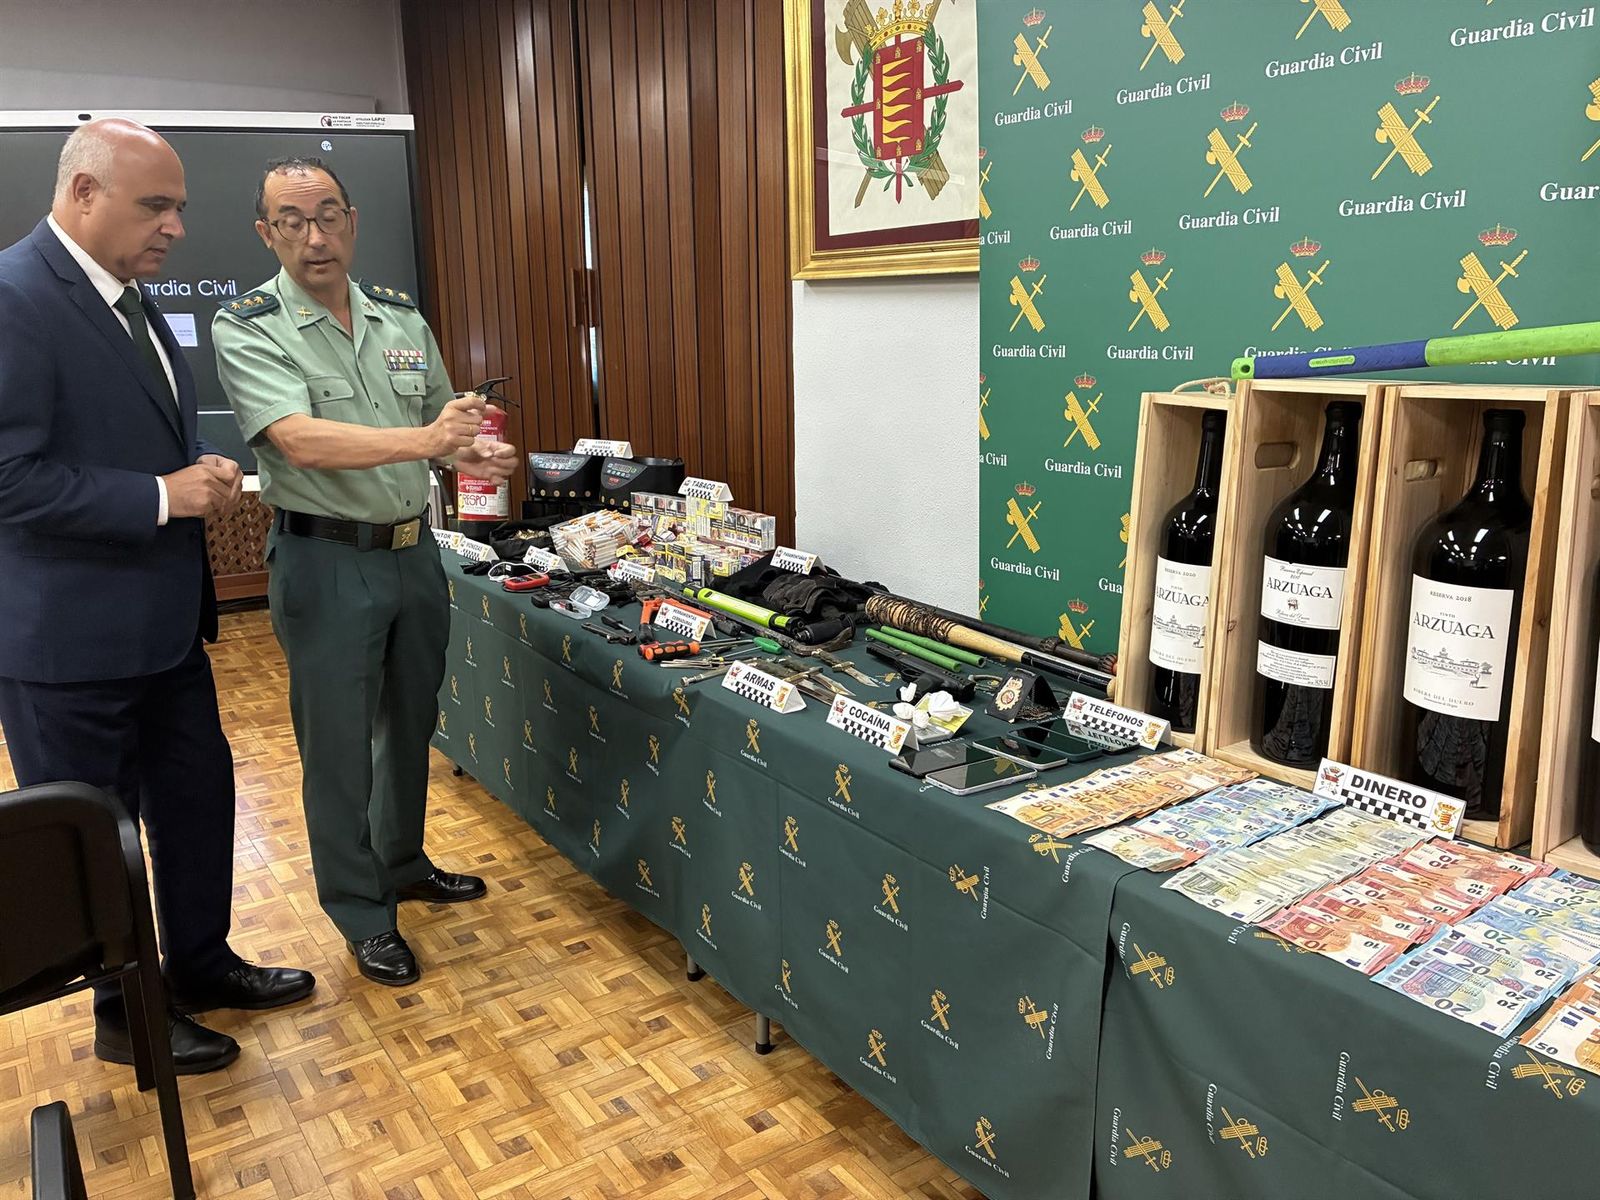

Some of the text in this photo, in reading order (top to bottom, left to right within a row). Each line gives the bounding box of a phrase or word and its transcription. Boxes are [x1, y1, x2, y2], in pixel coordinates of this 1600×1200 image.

[1450, 7, 1595, 47] Guardia Civil
[1265, 42, 1383, 78] Guardia Civil
[1116, 74, 1211, 105] Guardia Civil
[995, 100, 1073, 126] Guardia Civil
[1339, 190, 1467, 217] Guardia Civil
[1050, 220, 1132, 240] Guardia Civil
[1178, 207, 1280, 230] Guardia Civil
[987, 230, 1010, 245] Civil
[198, 280, 237, 296] Civil
[993, 345, 1066, 358] Guardia Civil
[1107, 345, 1193, 361] Guardia Civil
[986, 452, 1007, 467] Civil
[1045, 458, 1122, 478] Guardia Civil
[691, 480, 716, 491] TABACO
[991, 557, 1060, 581] Guardia Civil
[1266, 576, 1333, 599] ARZUAGA
[1413, 611, 1495, 639] ARZUAGA
[743, 672, 776, 692] ARMAS
[849, 705, 891, 732] COCAÍNA
[1089, 704, 1144, 727] TELÉFONOS
[1350, 774, 1428, 809] DINERO
[1163, 827, 1189, 839] 20
[1061, 850, 1080, 883] Guardia
[980, 887, 989, 920] Guardia
[873, 905, 908, 932] Guardia Civil
[1395, 922, 1411, 931] 10
[1227, 924, 1246, 944] Civil
[1363, 941, 1380, 949] 10
[1484, 930, 1514, 945] 20
[1456, 958, 1491, 976] 20
[1534, 969, 1556, 980] 20
[1434, 999, 1472, 1018] 20
[1497, 999, 1519, 1010] 20
[921, 1019, 959, 1050] Guardia Civil
[1046, 1002, 1059, 1060] Guardia Civil
[1534, 1042, 1559, 1055] 50
[859, 1056, 897, 1084] Guardia Civil
[1485, 1035, 1520, 1090] uardia Civil
[1332, 1051, 1350, 1121] Guardia Civil
[1206, 1083, 1217, 1121] Guardia
[1109, 1107, 1121, 1166] Guardia Civil
[965, 1145, 1010, 1178] Guardia Civil
